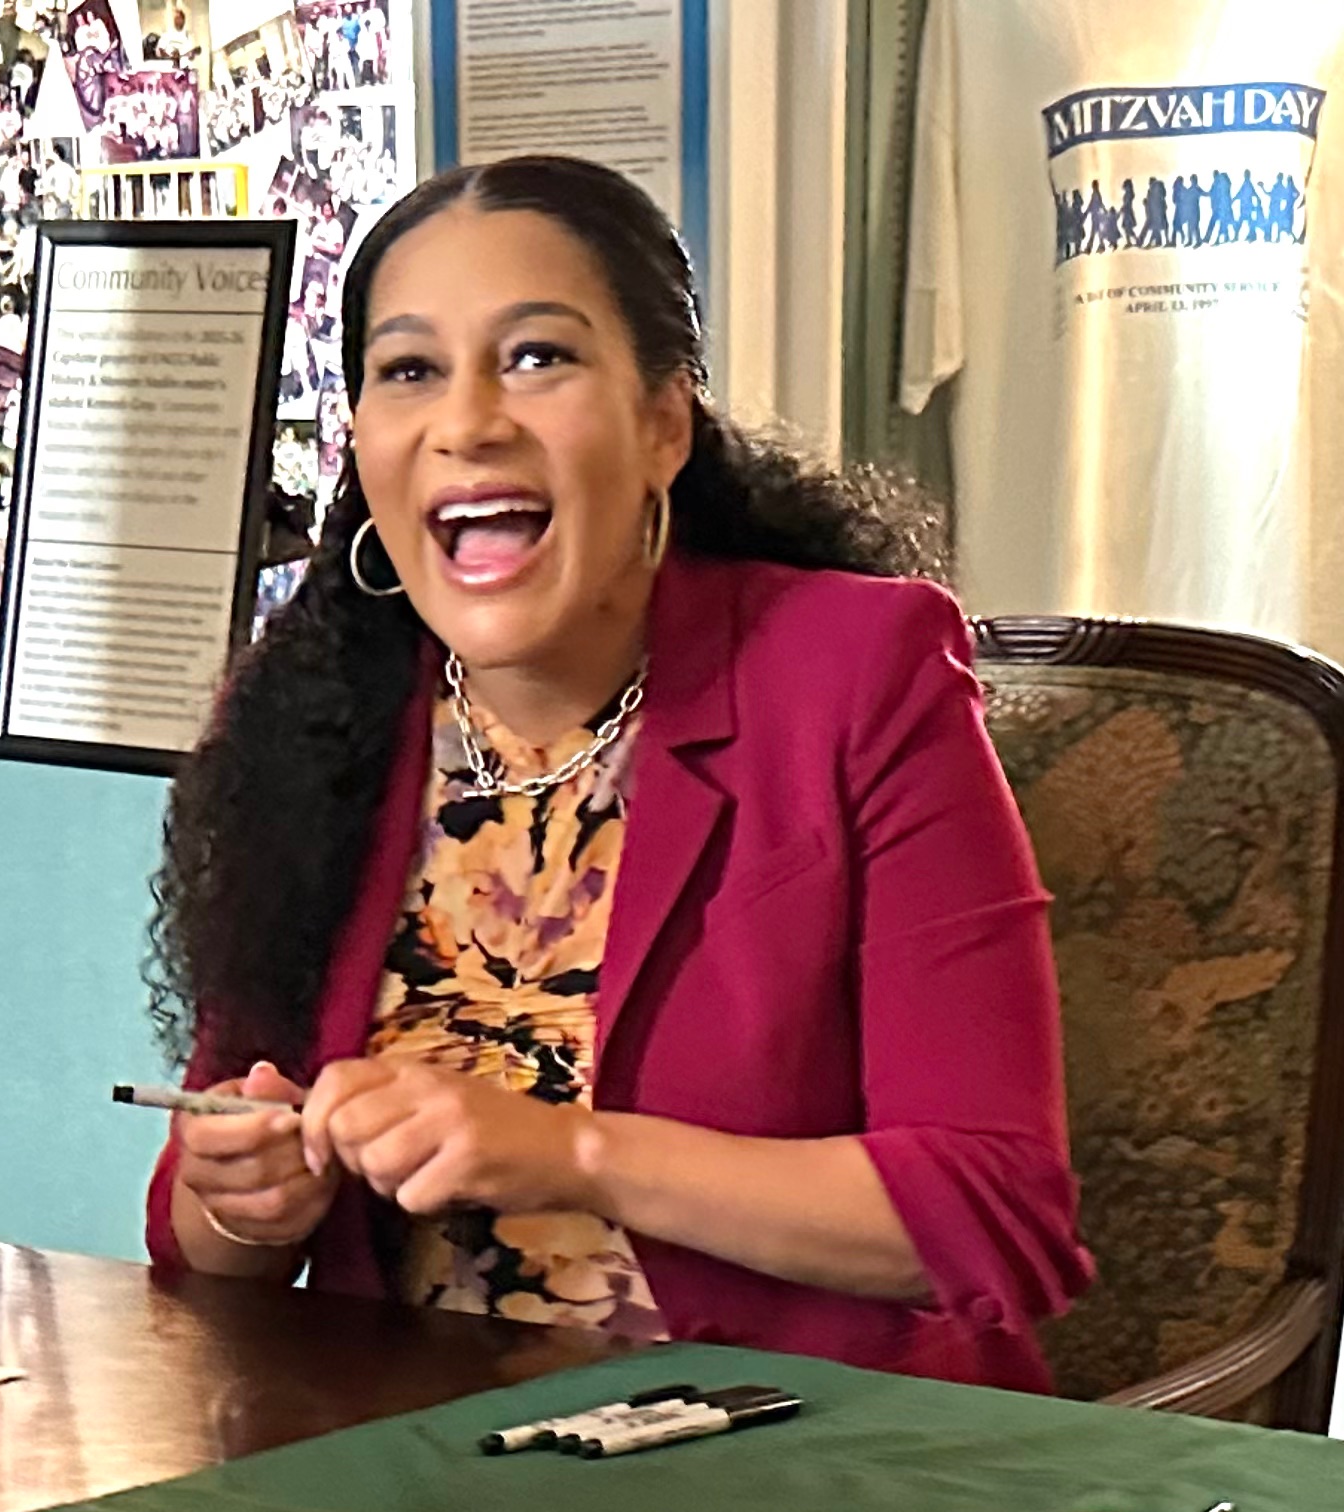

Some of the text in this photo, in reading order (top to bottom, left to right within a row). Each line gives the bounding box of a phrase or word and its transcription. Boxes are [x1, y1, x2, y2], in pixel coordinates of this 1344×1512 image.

[1053, 88, 1319, 147] MITZVAH DAY
[57, 260, 269, 299] Community Voice
[1128, 282, 1218, 299] COMMUNITY
